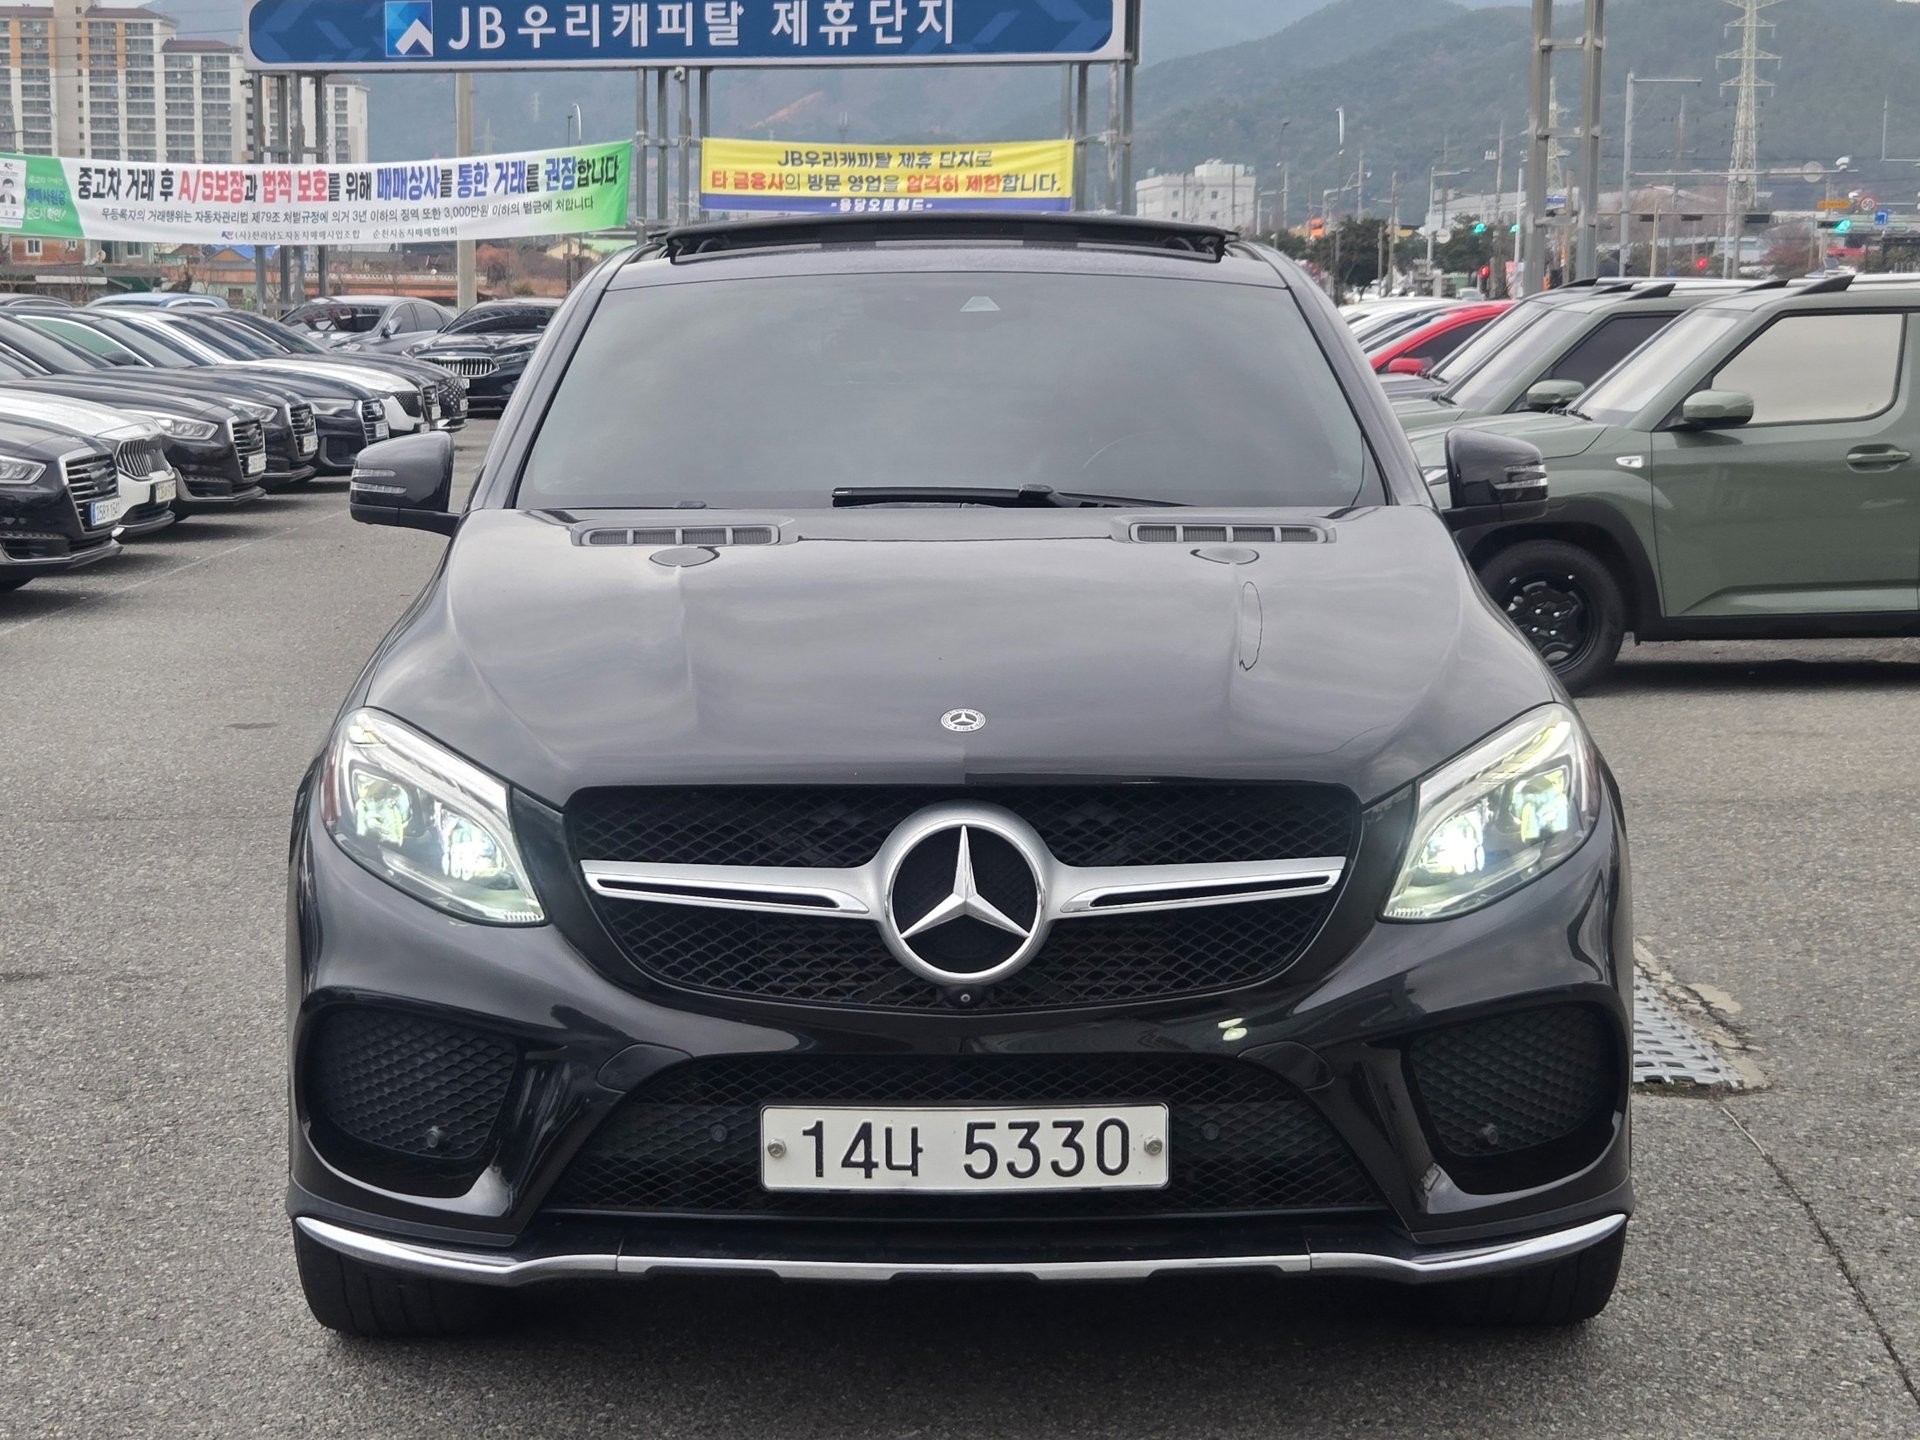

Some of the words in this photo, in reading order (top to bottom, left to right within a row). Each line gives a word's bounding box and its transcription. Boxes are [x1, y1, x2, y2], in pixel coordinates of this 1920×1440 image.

[449, 1, 745, 50] JB우리캐피탈
[771, 0, 952, 47] 제휴단지
[778, 150, 893, 168] JB우리캐피탈
[897, 151, 933, 169] 제휴
[939, 151, 993, 169] 단지로
[78, 167, 122, 200] 중고차
[126, 167, 155, 201] 거래
[160, 168, 174, 202] 후
[178, 169, 258, 204] A/S보장과
[262, 170, 292, 203] 법적
[297, 169, 341, 202] 보호를
[346, 171, 372, 202] 위해
[377, 164, 453, 201] 매매상사를
[457, 161, 489, 198] 통한
[493, 159, 540, 196] 거래를
[544, 154, 620, 193] 권장합니다
[711, 170, 729, 188] 타
[733, 171, 801, 191] 금융사의
[807, 173, 842, 191] 방문
[847, 174, 900, 192] 영업을
[907, 174, 959, 193] 엄격히
[966, 173, 1062, 193] 제한합니다.
[102, 207, 146, 221] 무등록자의
[148, 209, 192, 223] 거래행위는
[195, 210, 249, 224] 자동차관리법
[252, 210, 281, 224] 제79조
[332, 210, 350, 223] 의거
[352, 209, 367, 223] 3년
[370, 208, 398, 223] 이하의
[422, 206, 441, 221] 또한
[444, 204, 489, 220] 3,000만원
[492, 202, 520, 217] 이하의
[802, 1119, 924, 1179] 14나
[963, 1117, 1130, 1180] 5330
